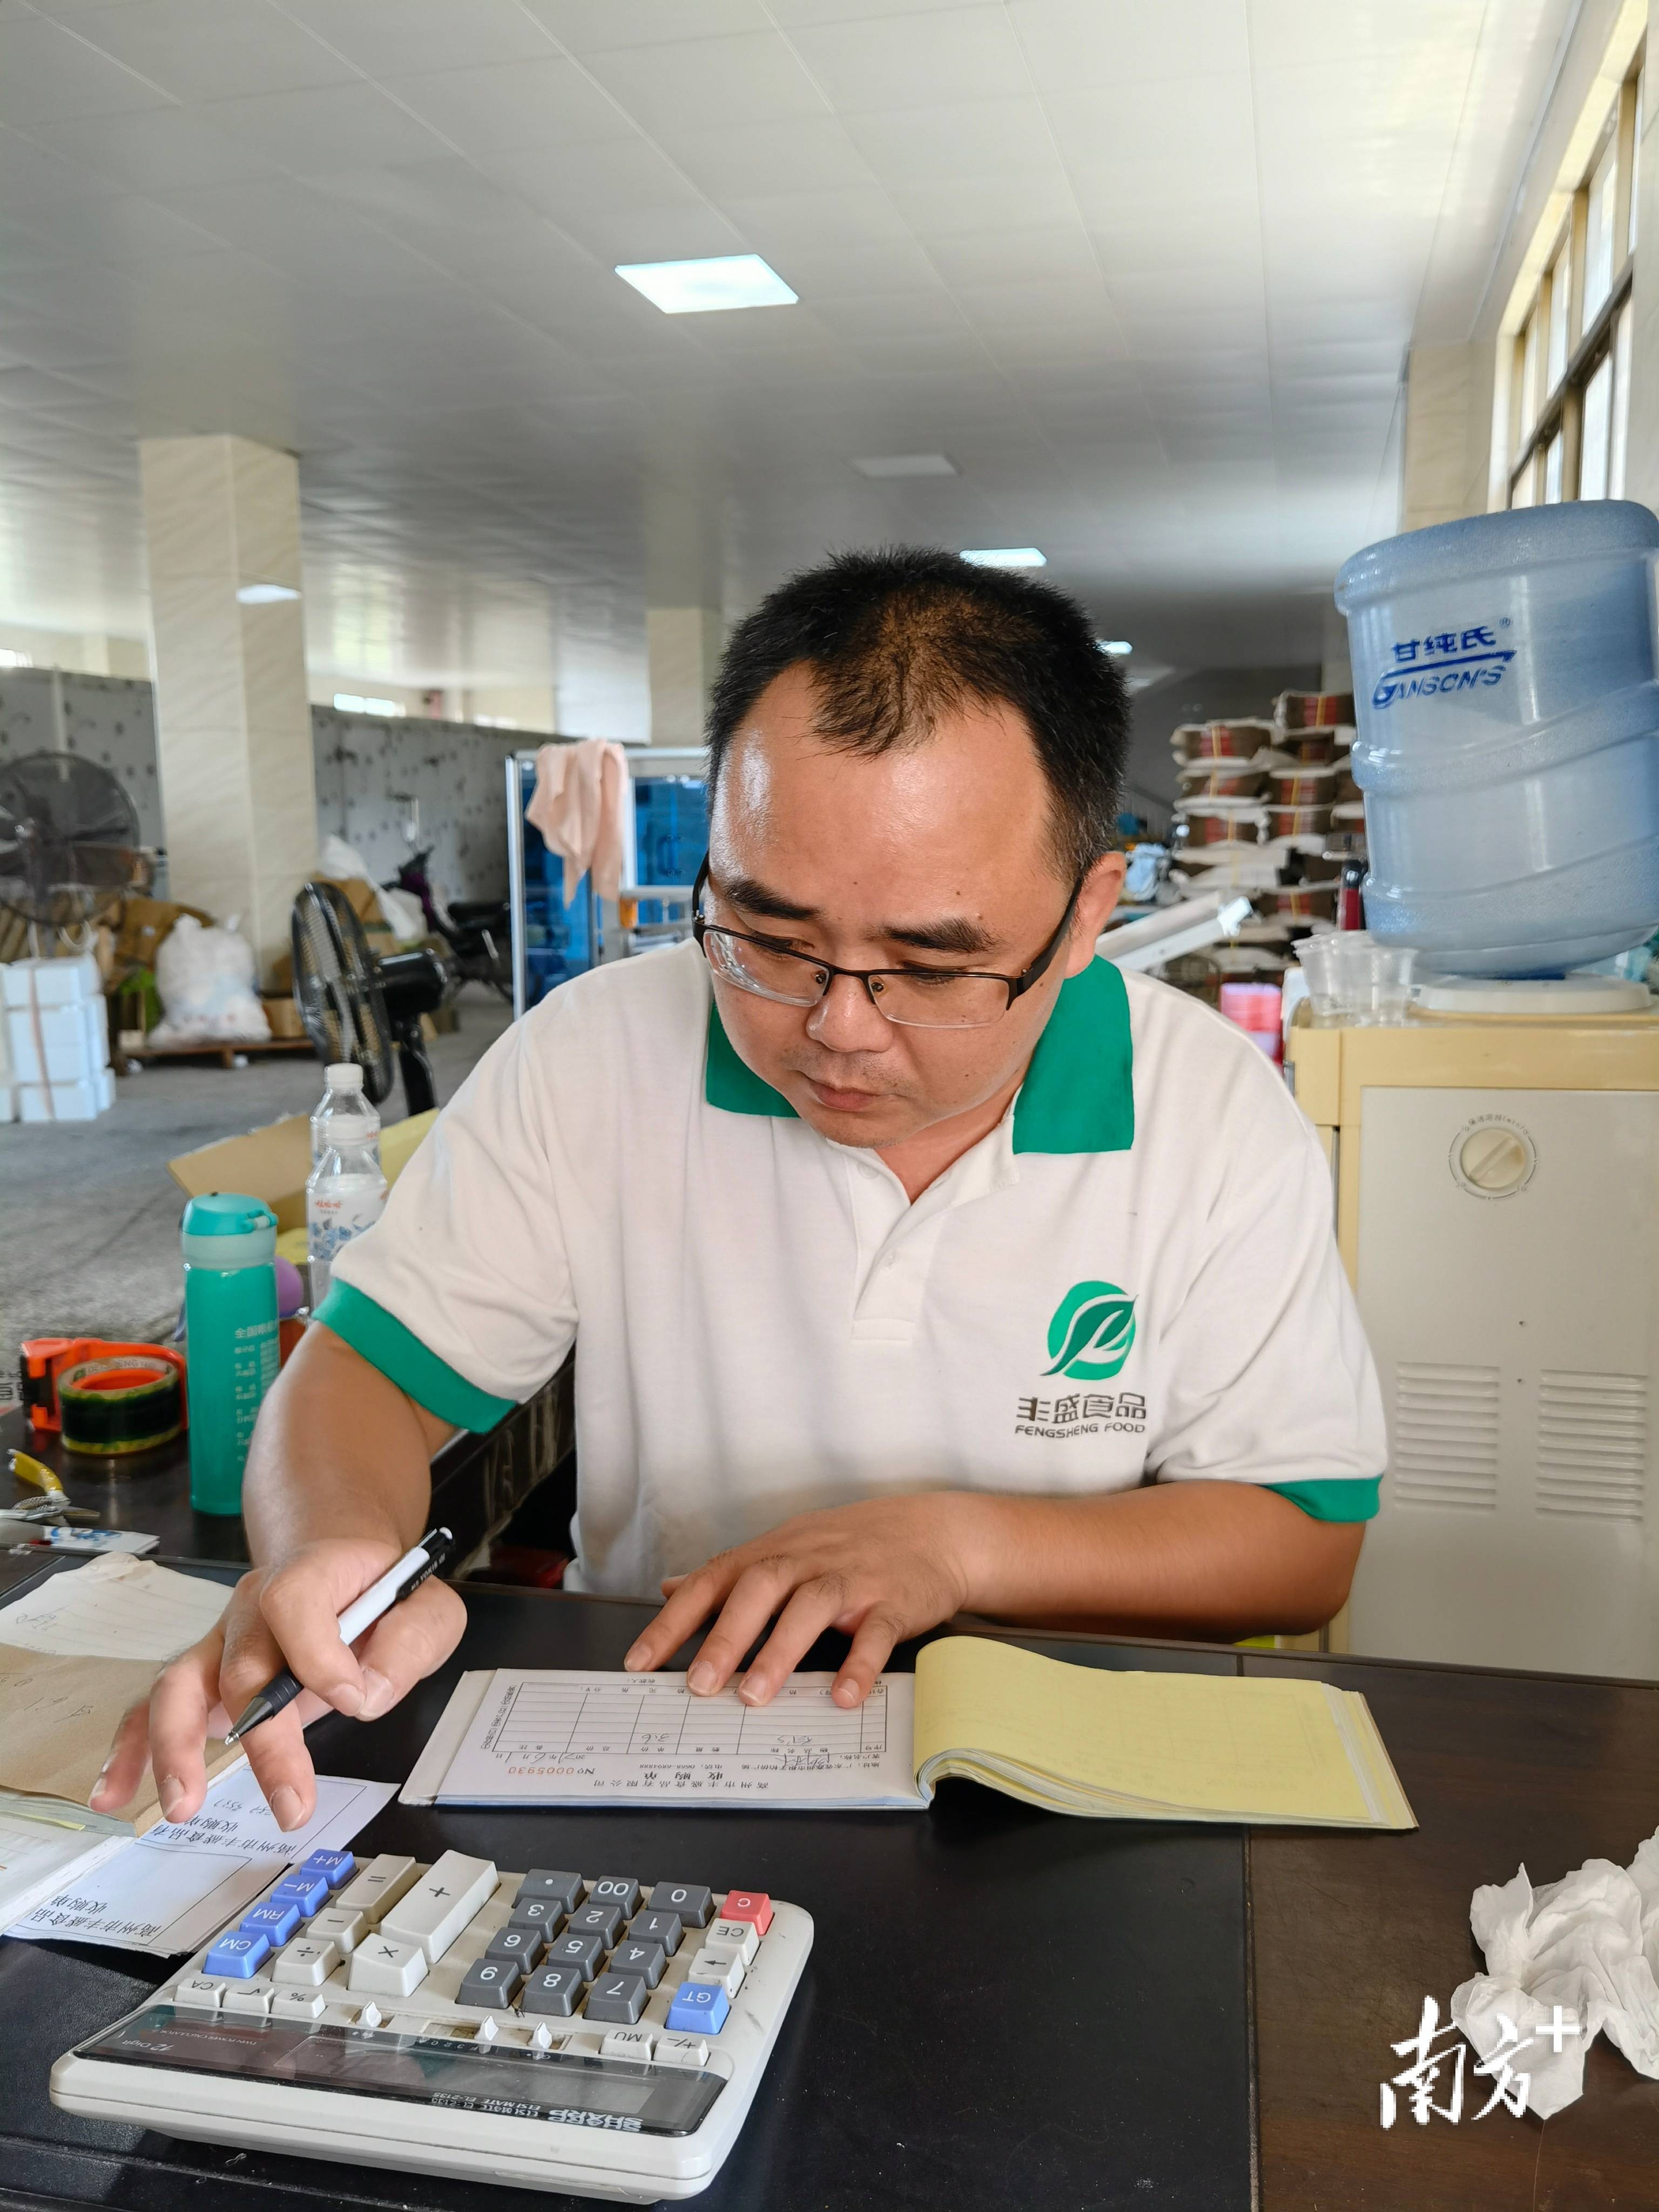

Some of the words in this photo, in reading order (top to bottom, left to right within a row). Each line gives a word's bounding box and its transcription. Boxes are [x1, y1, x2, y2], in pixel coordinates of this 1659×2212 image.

[1392, 626, 1496, 662] 甘纯氏
[1016, 1392, 1147, 1424] 丰盛食品
[1015, 1424, 1098, 1439] FENGSHENG
[1104, 1422, 1145, 1433] FOOD
[508, 1766, 575, 1775] 0005930
[644, 1771, 723, 1780] 收购单
[593, 1779, 768, 1789] 高州市丰盛食品有限公司
[313, 1855, 342, 1865] M+
[597, 1881, 629, 1896] 00
[671, 1889, 687, 1903] 0
[737, 1898, 751, 1907] C
[50, 1894, 107, 1914] 收购单
[528, 1904, 544, 1917] 3
[252, 1908, 285, 1920] RM
[585, 1910, 604, 1923] 2
[30, 1908, 162, 1937] 高州市丰盛食品
[648, 1917, 658, 1930] 1
[717, 1926, 744, 1938] CE
[219, 1938, 252, 1951] CM
[504, 1934, 521, 1947] 6
[565, 1940, 584, 1954] 5
[629, 1947, 645, 1960] 4
[480, 1966, 498, 1980] 9
[191, 1979, 214, 1991] CA
[542, 1973, 561, 1987] 8
[606, 1980, 624, 1994] 7
[682, 1991, 711, 2003] GT
[613, 2031, 643, 2042] MU
[122, 2039, 152, 2048] Digit
[432, 2092, 477, 2102] EL-2135
[548, 2108, 643, 2128] SHARP
